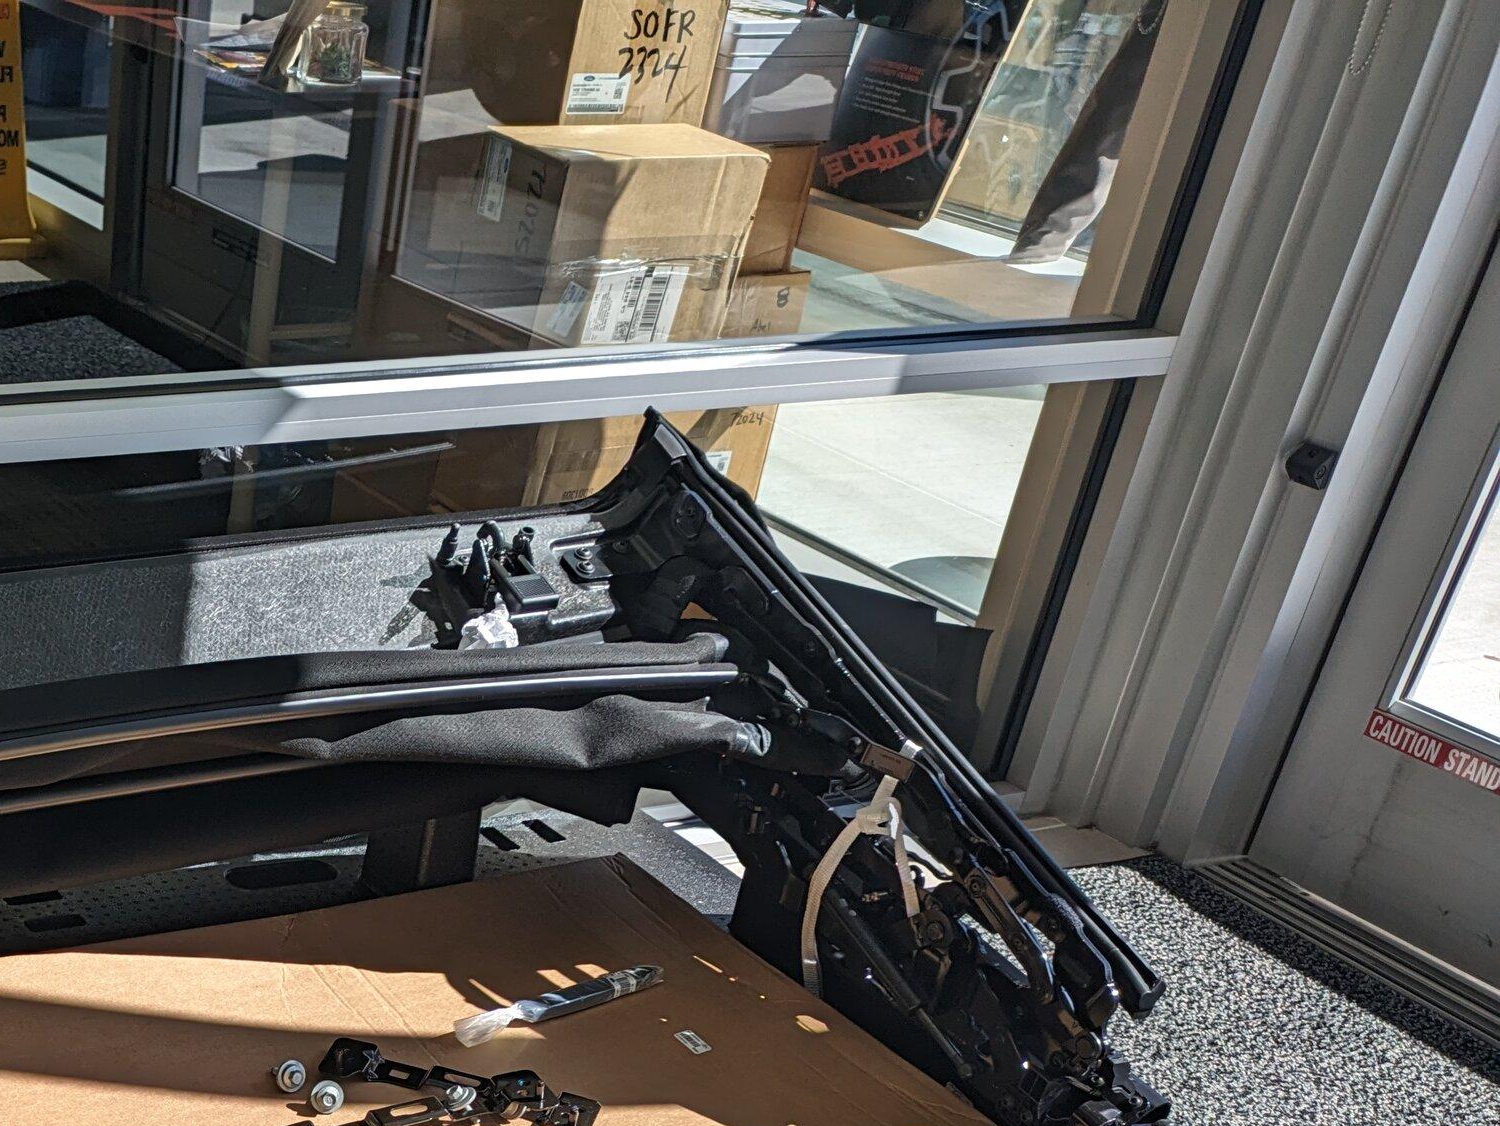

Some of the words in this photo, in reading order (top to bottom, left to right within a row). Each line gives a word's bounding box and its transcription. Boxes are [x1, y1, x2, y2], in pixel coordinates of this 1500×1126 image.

[618, 45, 688, 103] 2324
[1369, 715, 1443, 765] CAUTION
[1443, 748, 1500, 791] STAND
